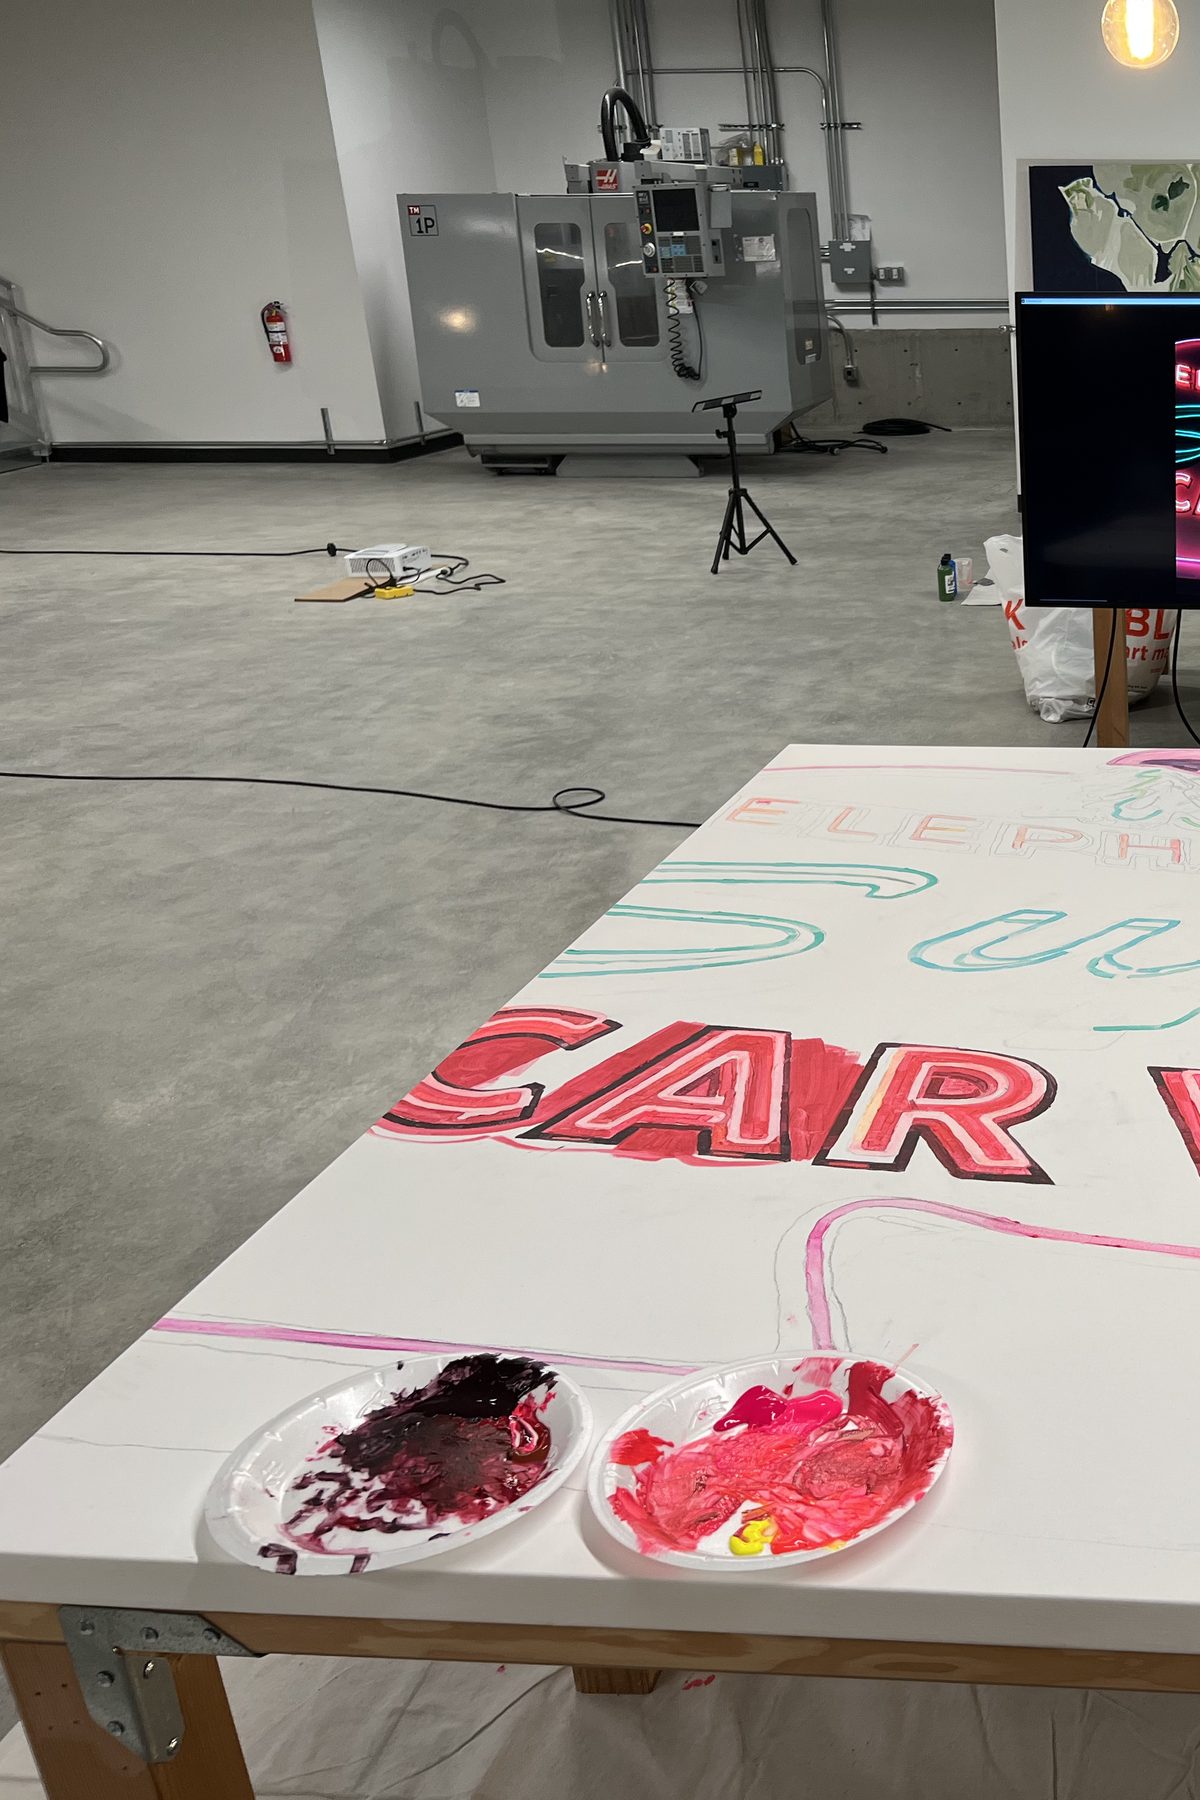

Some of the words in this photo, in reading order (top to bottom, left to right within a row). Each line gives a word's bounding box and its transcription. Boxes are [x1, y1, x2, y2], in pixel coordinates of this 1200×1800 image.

[409, 206, 420, 214] TM
[415, 217, 435, 234] 1P
[370, 1005, 1056, 1186] CAR
